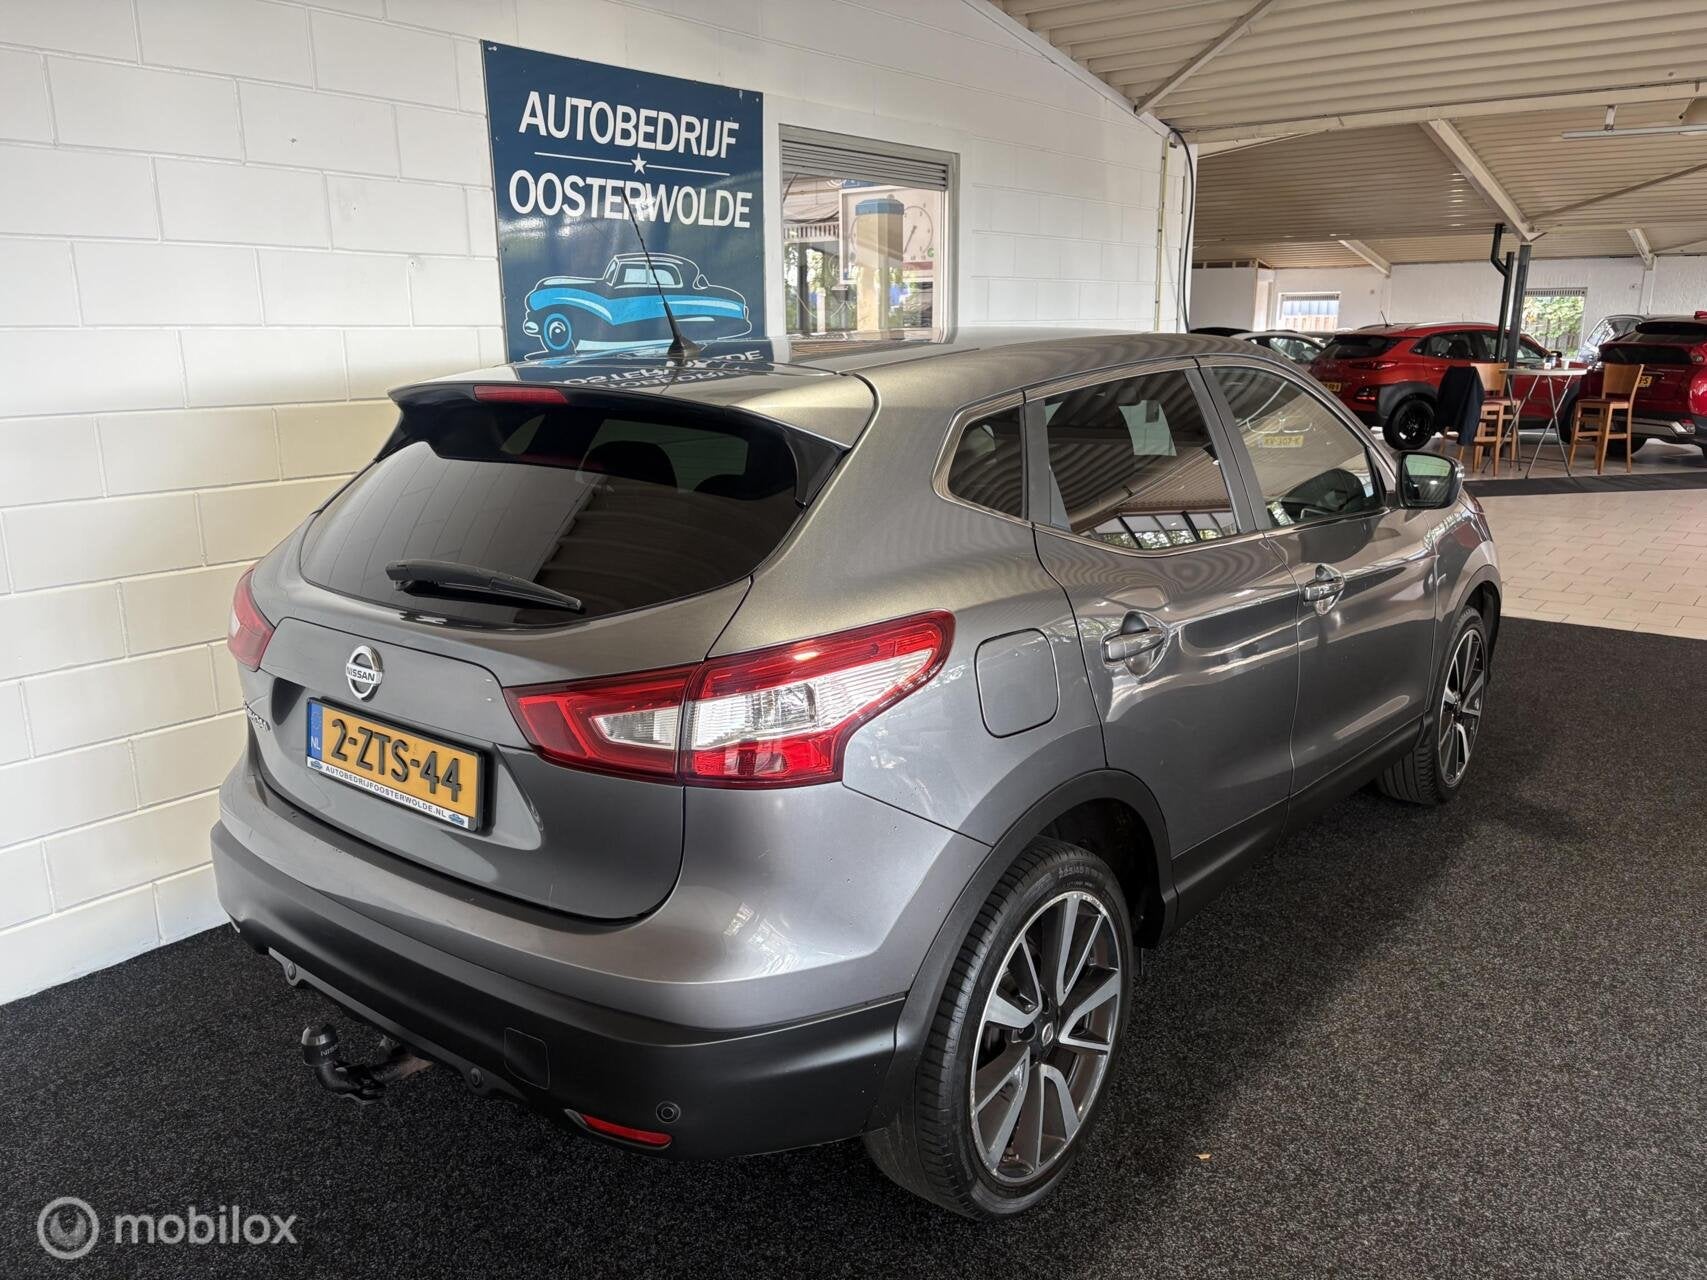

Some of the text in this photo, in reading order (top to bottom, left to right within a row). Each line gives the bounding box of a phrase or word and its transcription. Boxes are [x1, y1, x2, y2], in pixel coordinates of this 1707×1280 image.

[518, 90, 740, 159] AUTOBEDRIJF
[509, 169, 753, 229] OOSTERWOLDE
[310, 735, 321, 751] NL
[330, 718, 462, 803] 2-ZTS-44
[325, 765, 446, 818] AUTOBEDRIJFOOSTERWOLDE.NL
